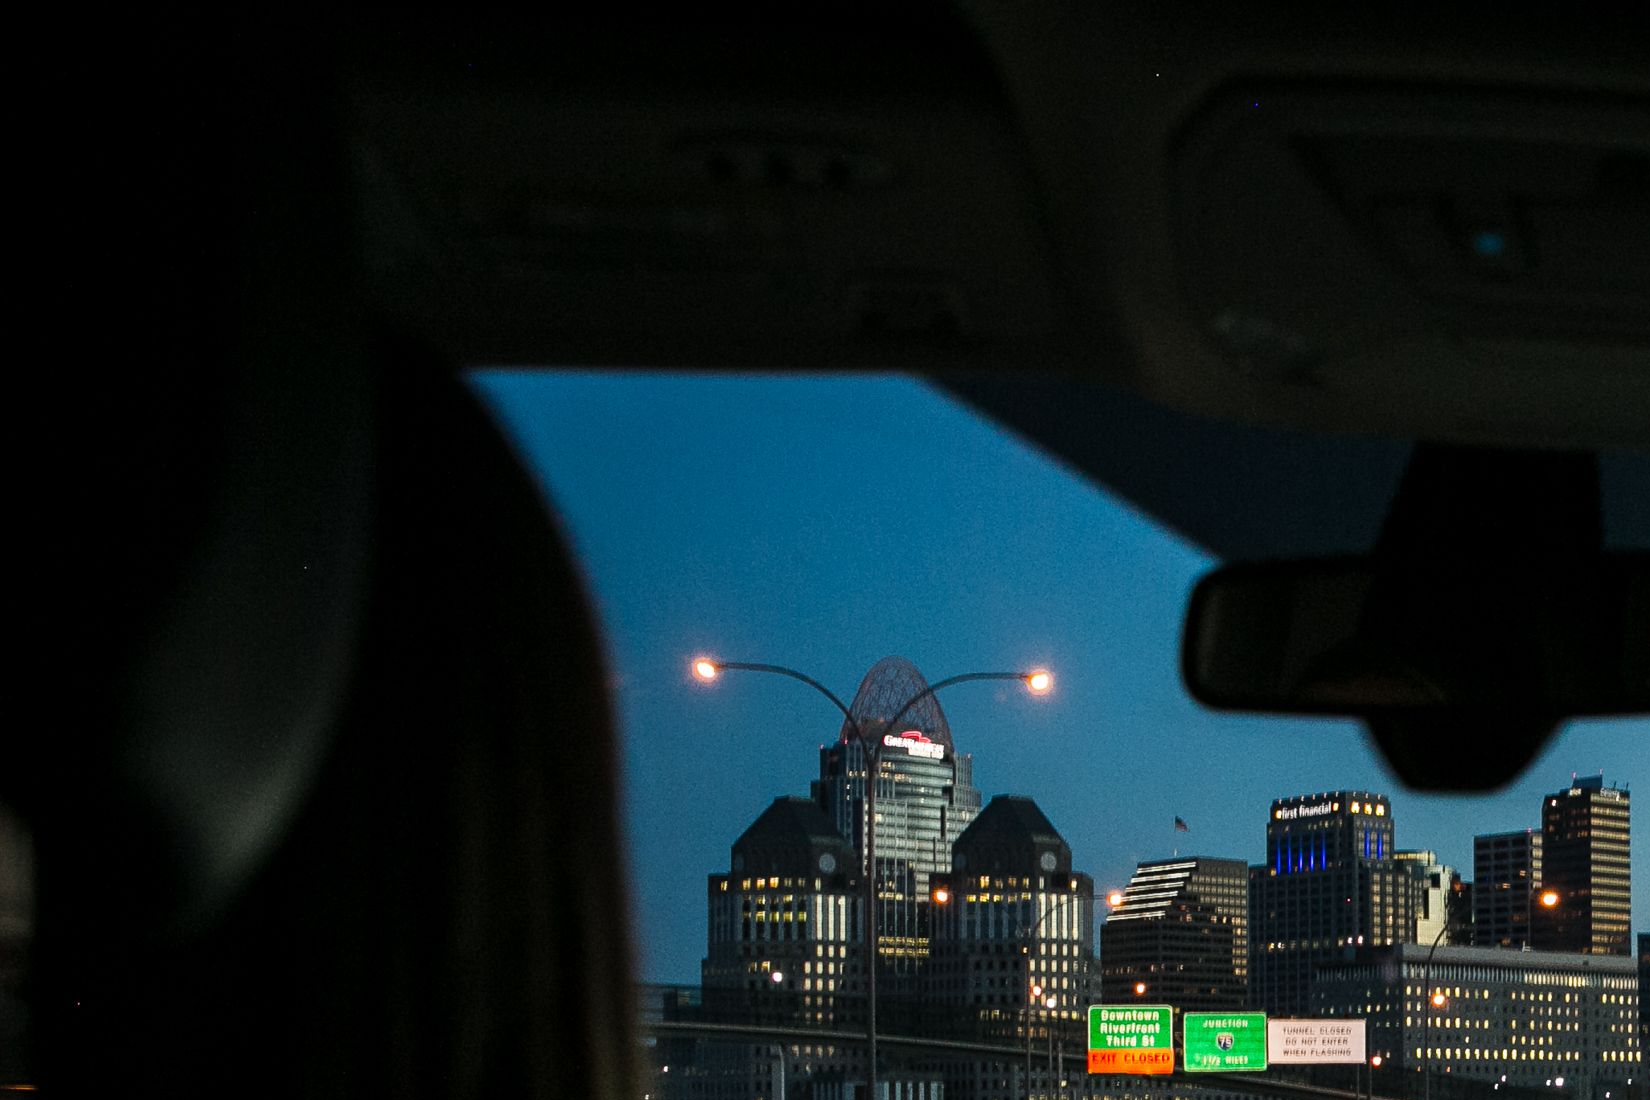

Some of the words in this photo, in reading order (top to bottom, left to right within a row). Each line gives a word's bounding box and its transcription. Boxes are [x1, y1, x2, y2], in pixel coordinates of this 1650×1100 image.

[1282, 807, 1297, 820] first
[1299, 801, 1332, 817] financial
[1101, 1010, 1160, 1021] Downtown
[1100, 1022, 1160, 1034] Riverfront
[1202, 1019, 1248, 1028] JUNCTION
[1283, 1026, 1315, 1035] TUNNEL
[1320, 1026, 1352, 1035] CLOSED
[1106, 1035, 1137, 1047] Third
[1142, 1035, 1154, 1047] St
[1219, 1036, 1232, 1047] 75
[1285, 1037, 1297, 1046] DO
[1301, 1037, 1317, 1046] NOT
[1322, 1037, 1348, 1046] ENTER
[1283, 1048, 1307, 1057] WHEN
[1310, 1048, 1351, 1057] FLASHING
[1092, 1053, 1117, 1064] EXIT
[1124, 1053, 1170, 1064] CLOSED
